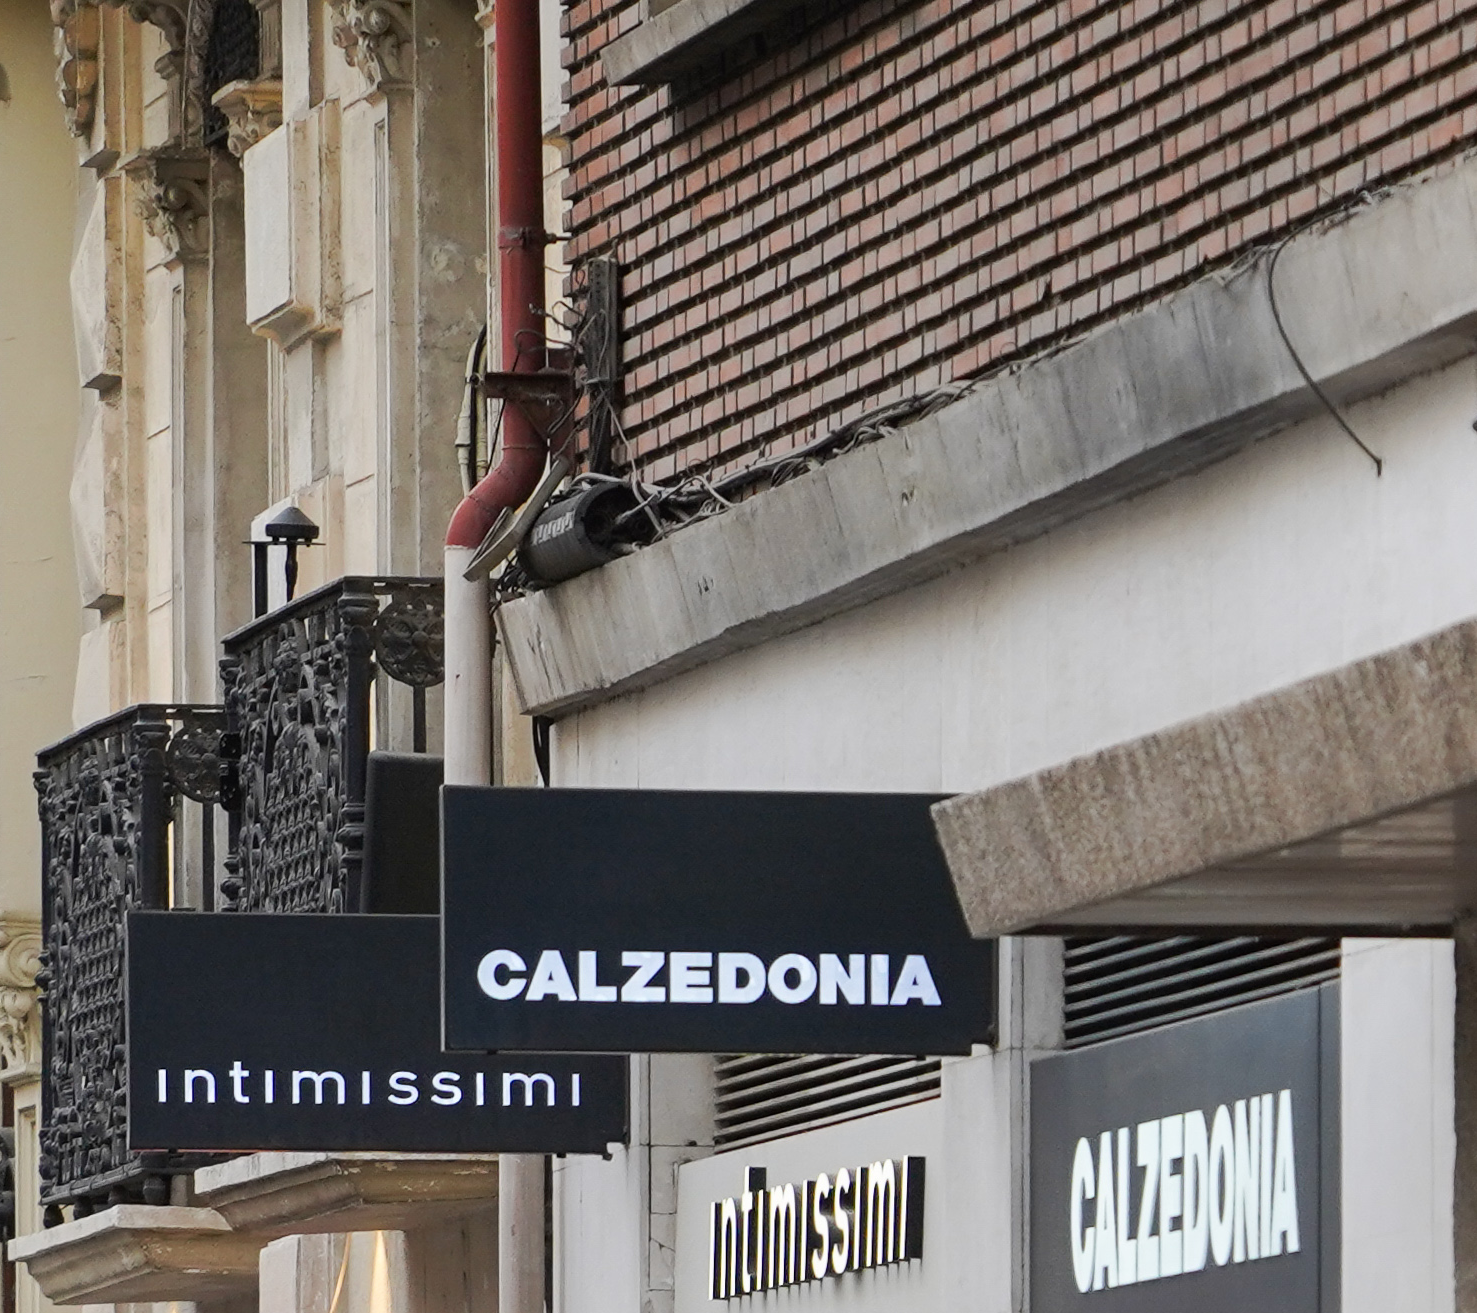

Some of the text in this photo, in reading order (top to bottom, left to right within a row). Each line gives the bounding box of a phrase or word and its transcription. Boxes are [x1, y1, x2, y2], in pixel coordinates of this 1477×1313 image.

[477, 949, 942, 1006] CALZEDONIA
[158, 1060, 582, 1107] intimissimi
[708, 1156, 920, 1300] intimissimi
[1070, 1089, 1301, 1293] CALZEDONIA
